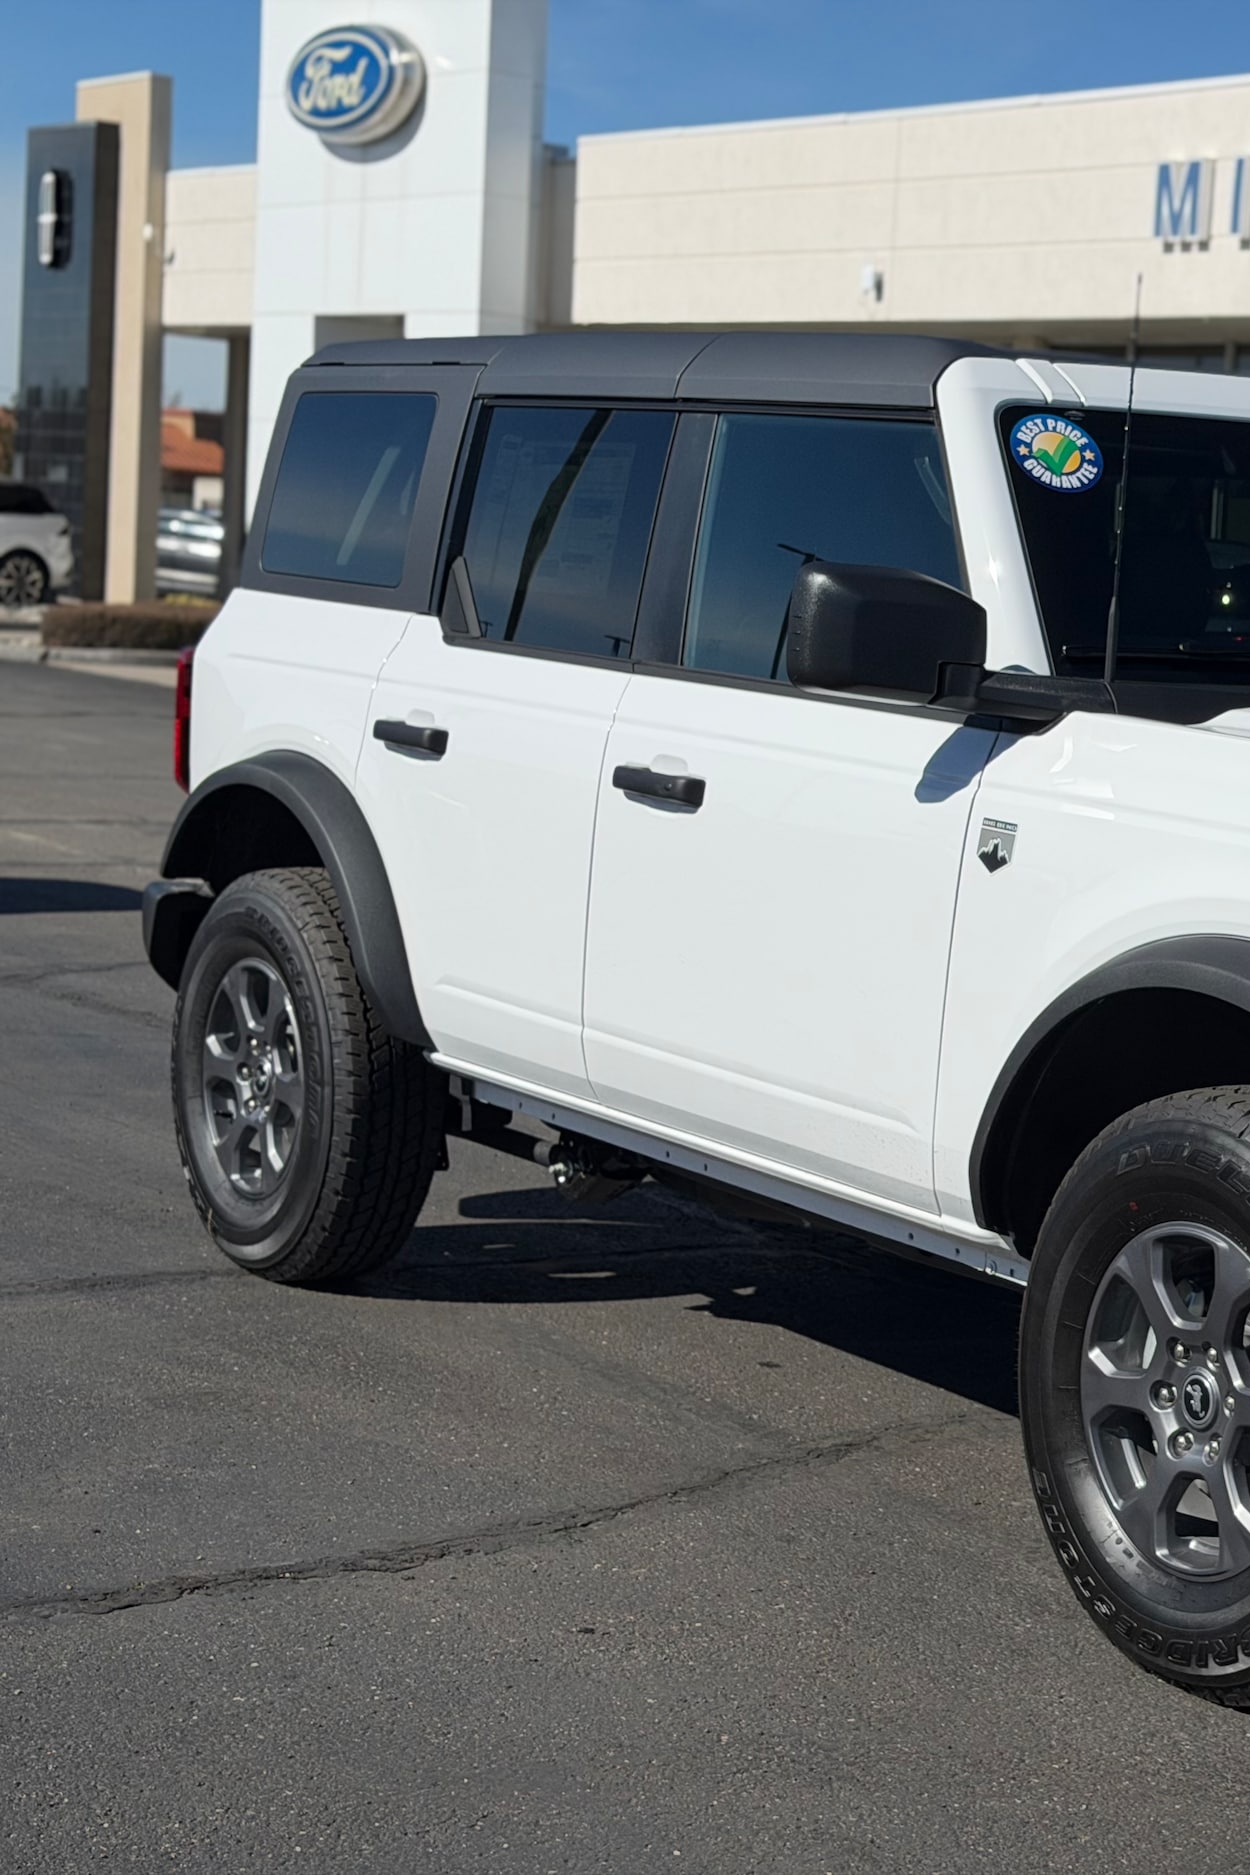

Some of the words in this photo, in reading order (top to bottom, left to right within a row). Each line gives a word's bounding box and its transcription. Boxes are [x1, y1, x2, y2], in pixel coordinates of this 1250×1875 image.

[298, 46, 367, 113] Ford
[1016, 418, 1045, 444] BEST
[1046, 418, 1089, 448] PRICE
[1023, 458, 1099, 489] GUARANTEE
